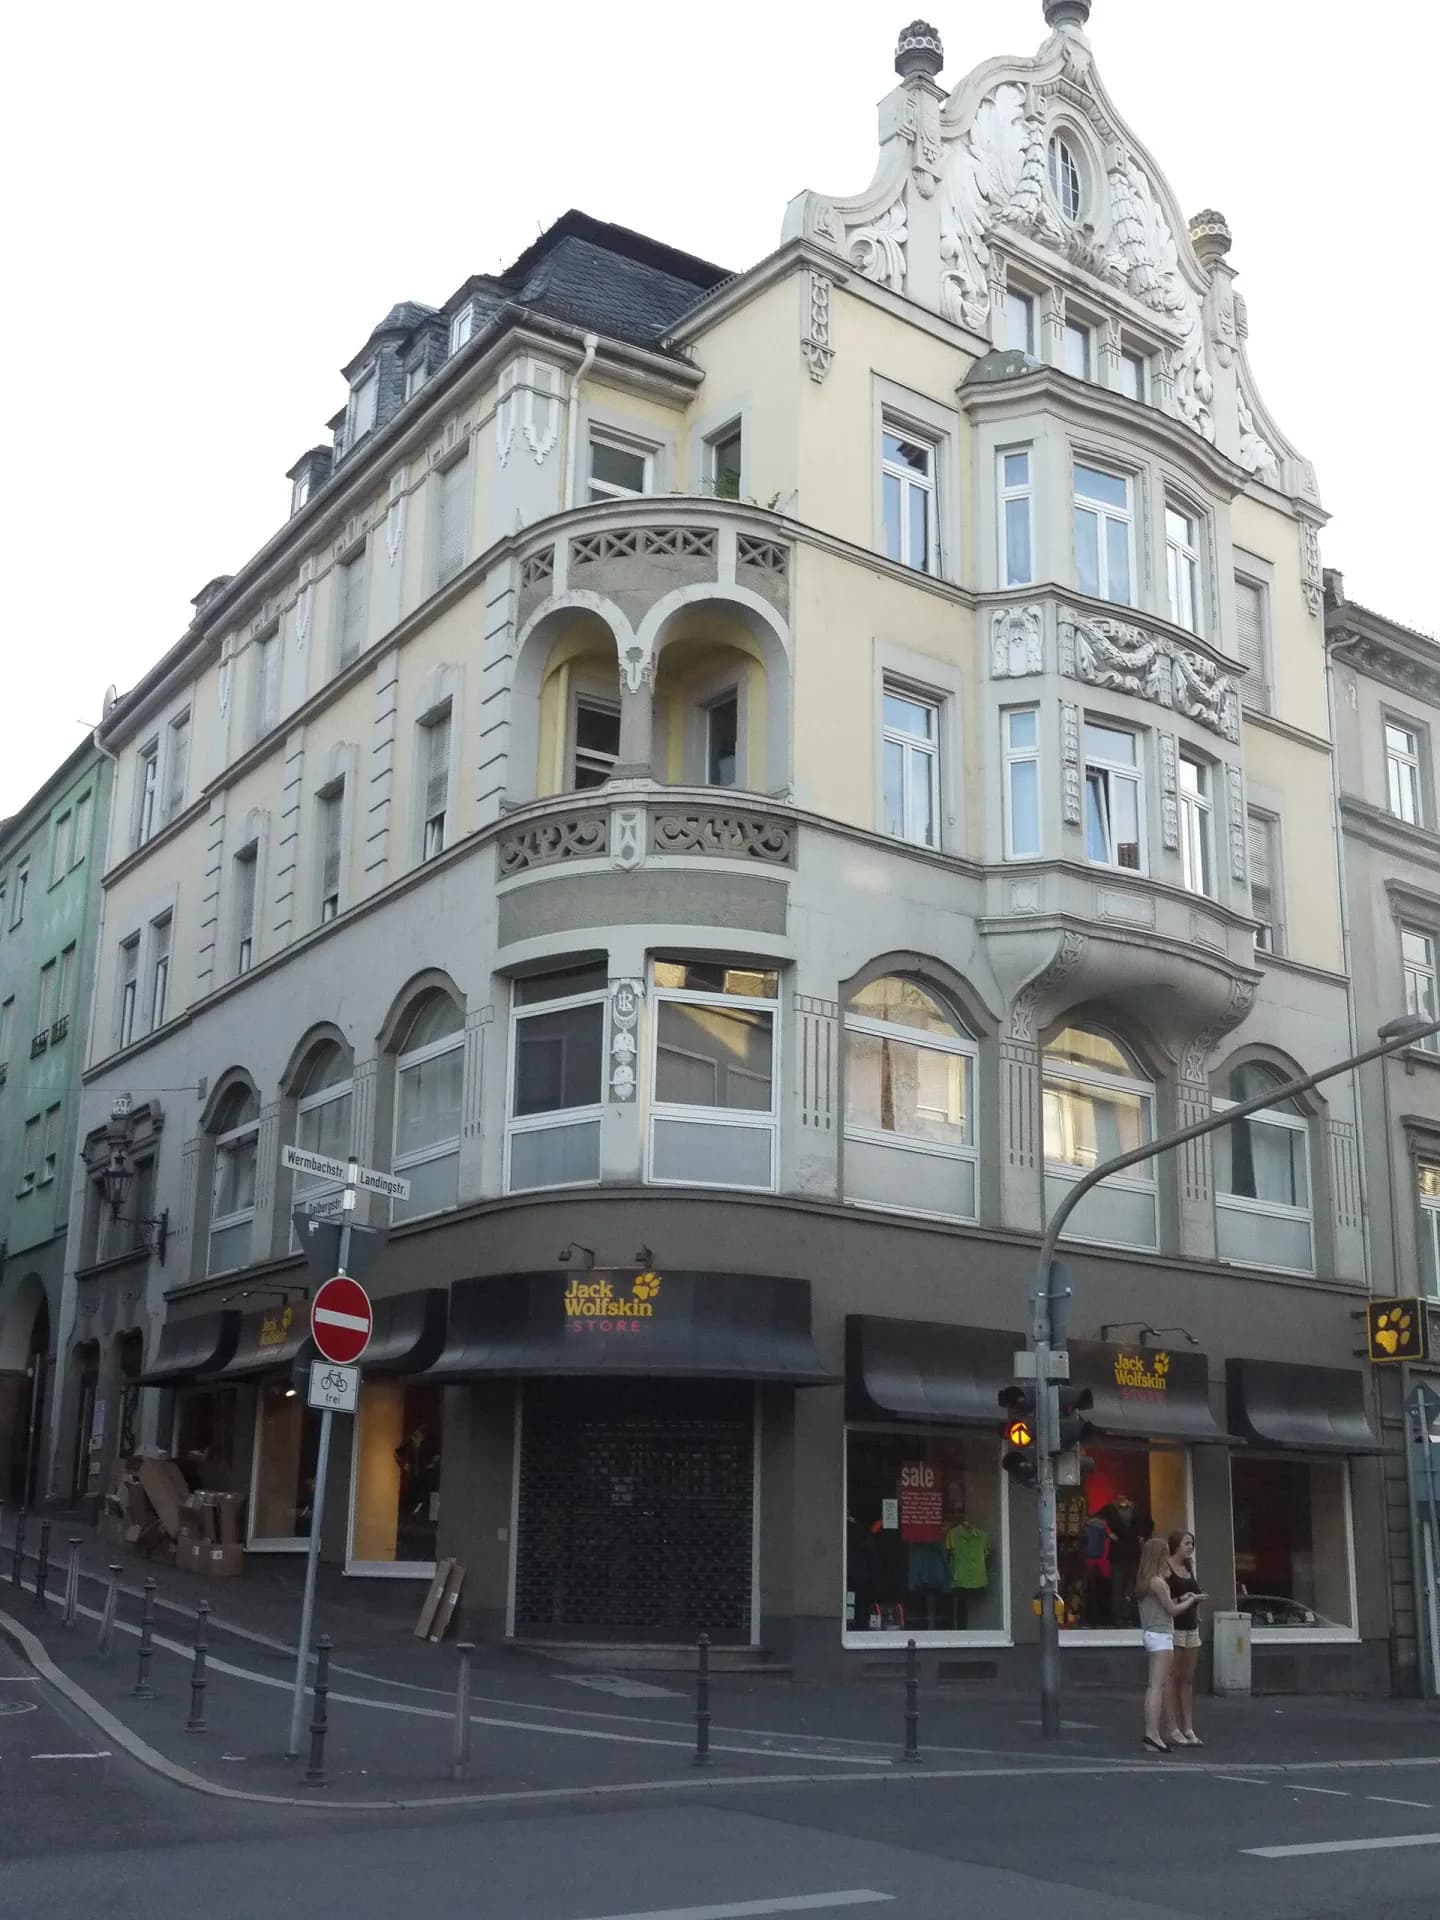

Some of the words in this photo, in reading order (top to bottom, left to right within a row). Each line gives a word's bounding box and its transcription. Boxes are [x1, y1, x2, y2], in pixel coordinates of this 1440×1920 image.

[287, 1150, 345, 1179] Wermbachstr.
[360, 1171, 406, 1195] Landingstr.
[564, 1280, 613, 1298] Jack
[564, 1298, 653, 1317] Wolfskin
[573, 1320, 641, 1332] STORE
[1114, 1353, 1144, 1371] Jack
[1114, 1369, 1166, 1390] Wolfskin
[326, 1393, 341, 1404] frei
[901, 1461, 934, 1488] sale
